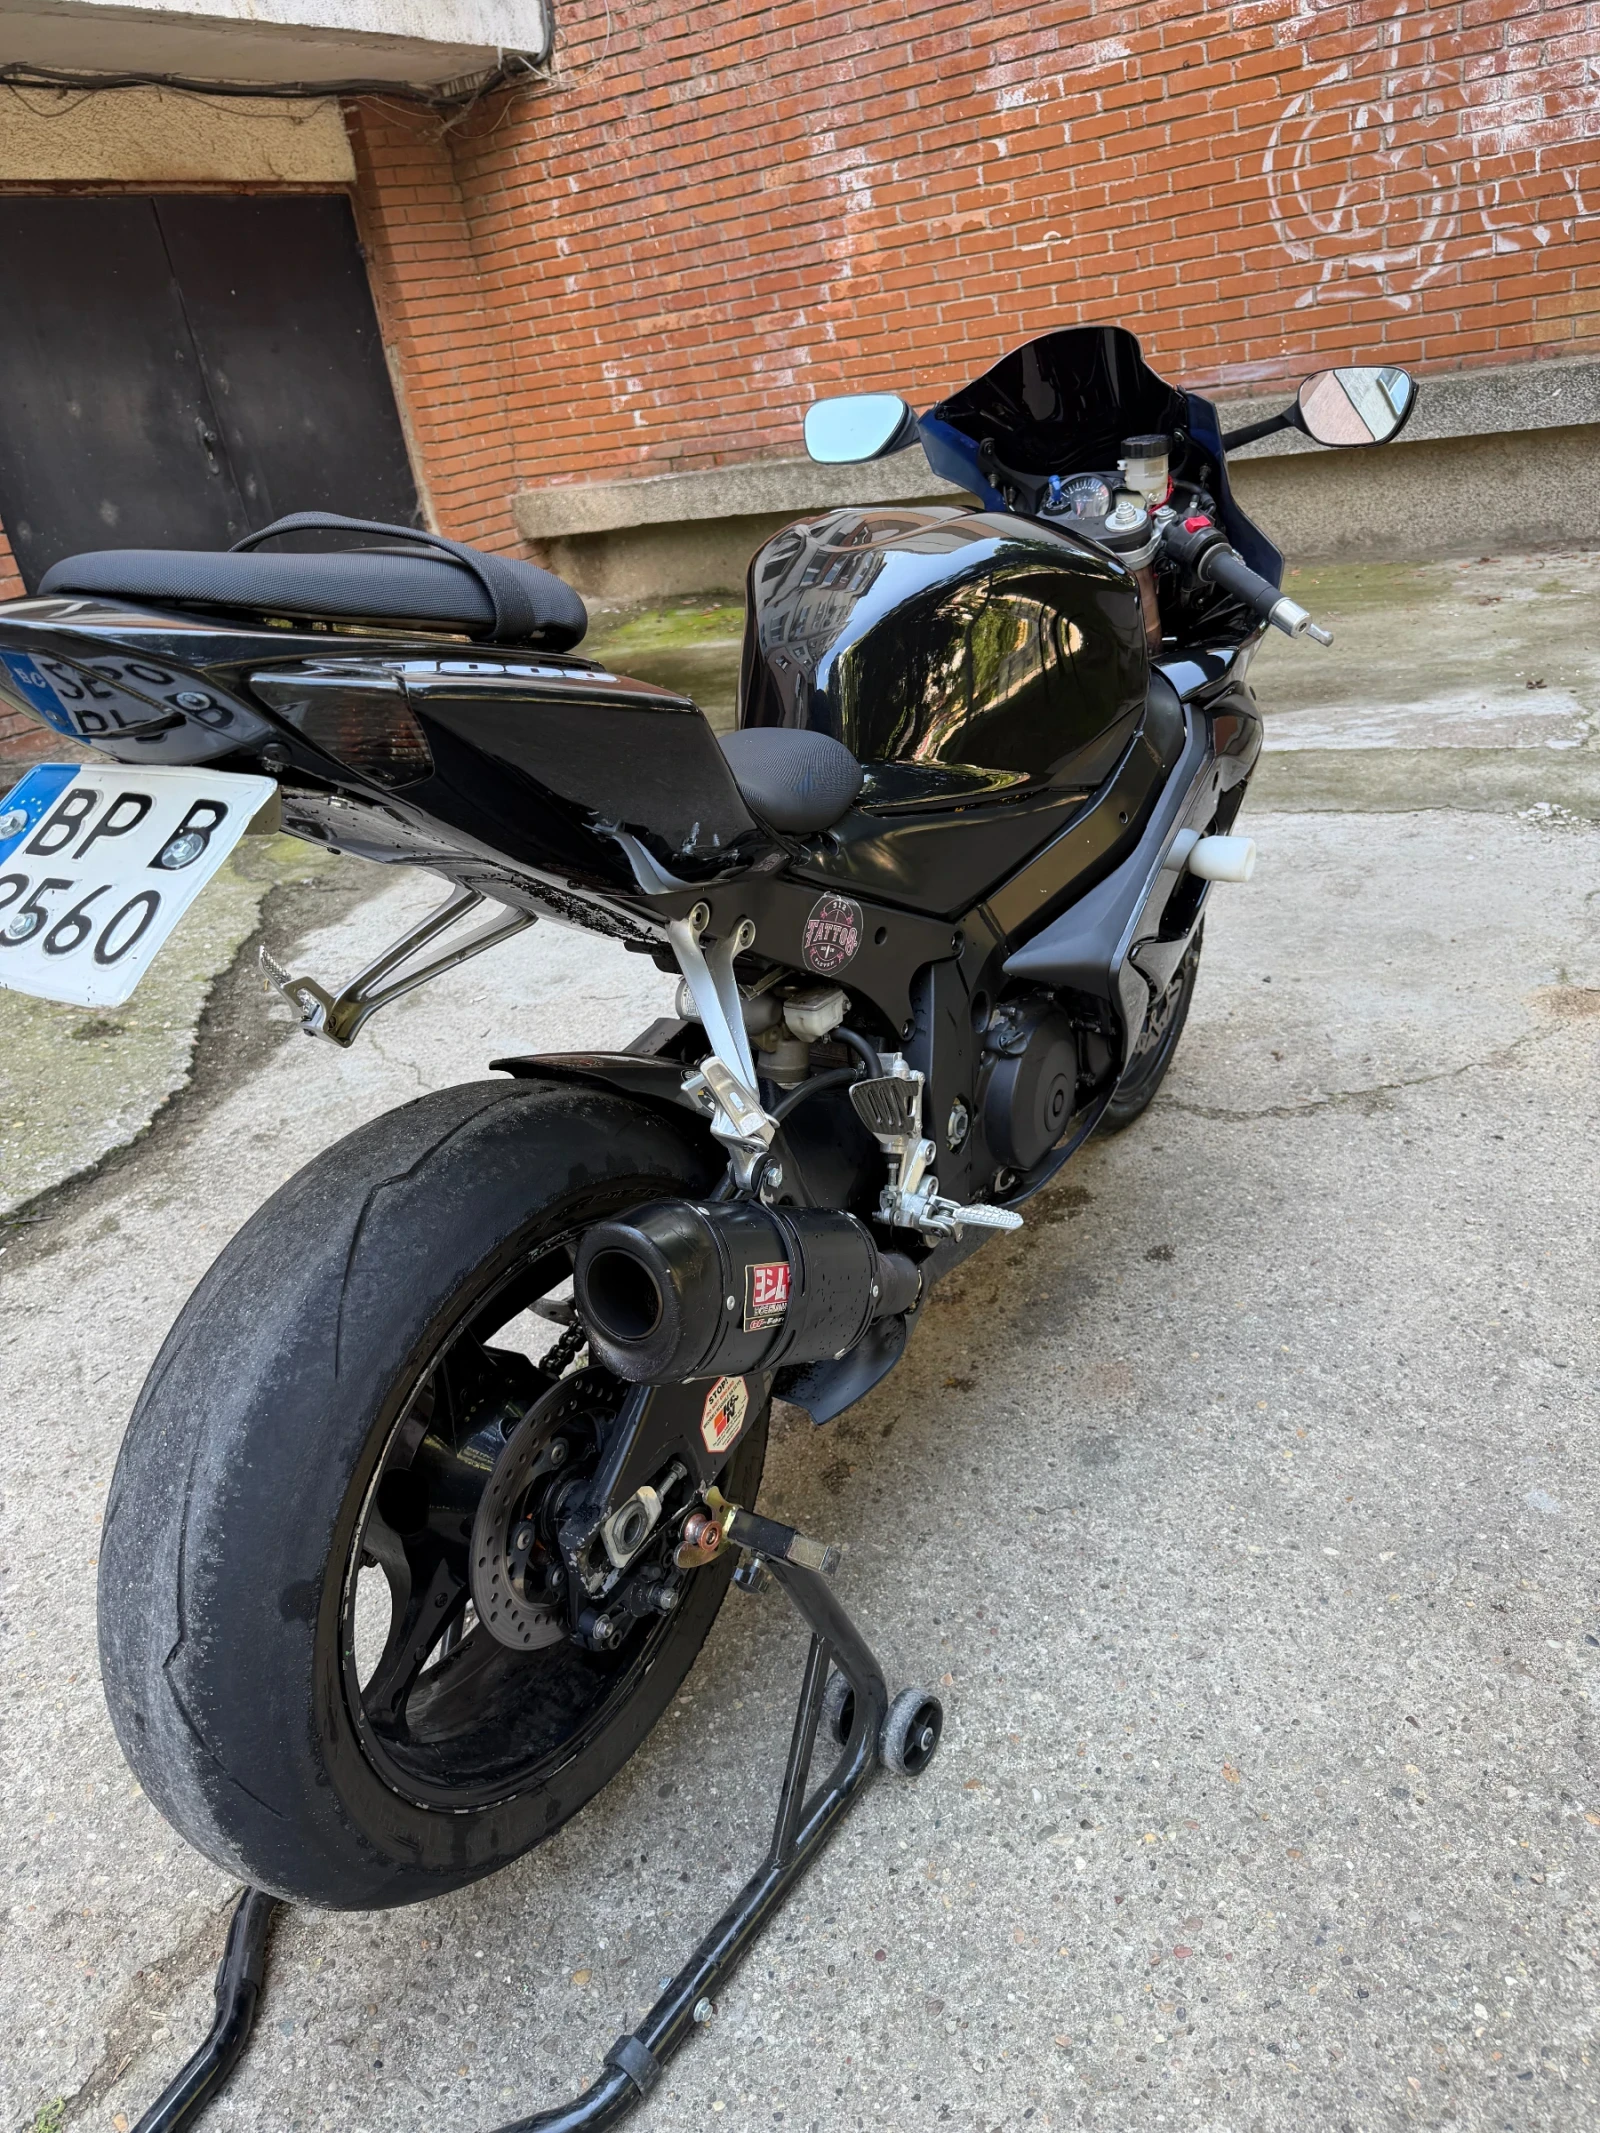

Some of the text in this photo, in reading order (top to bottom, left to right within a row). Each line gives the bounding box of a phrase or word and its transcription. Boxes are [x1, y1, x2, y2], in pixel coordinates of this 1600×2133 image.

[23, 788, 229, 871] BP B
[805, 919, 858, 956] TATTOO
[709, 1378, 728, 1405] STOP!
